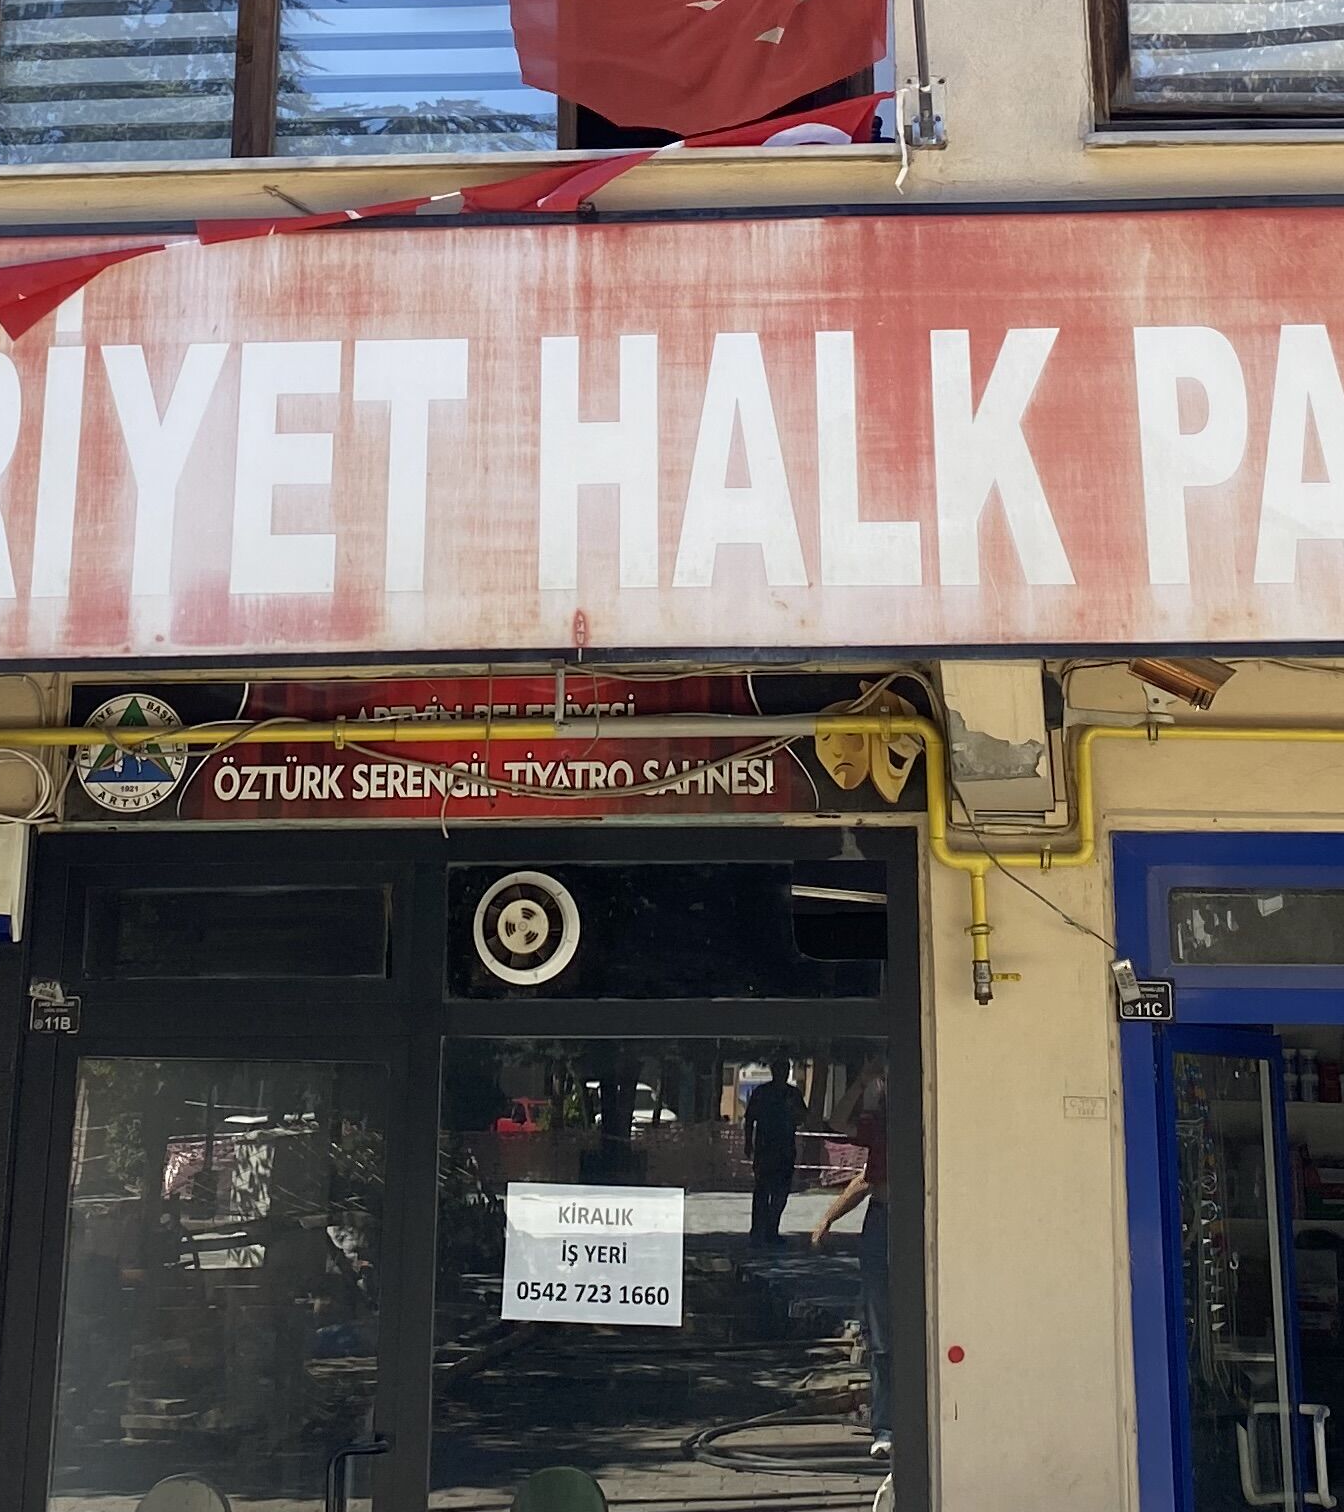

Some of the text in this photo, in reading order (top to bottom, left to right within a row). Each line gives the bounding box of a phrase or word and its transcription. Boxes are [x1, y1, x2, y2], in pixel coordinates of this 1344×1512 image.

[538, 326, 1076, 590] HALK
[214, 756, 345, 801] ÖZTÜRK
[352, 752, 497, 800] SERENGİL
[504, 752, 635, 797] TİYATRO
[1135, 1002, 1163, 1016] 11C
[44, 1016, 71, 1030] 11B
[558, 1202, 634, 1226] KİRALIK
[561, 1240, 627, 1266] İŞ YERİ
[517, 1281, 669, 1305] 0542 723 1660
